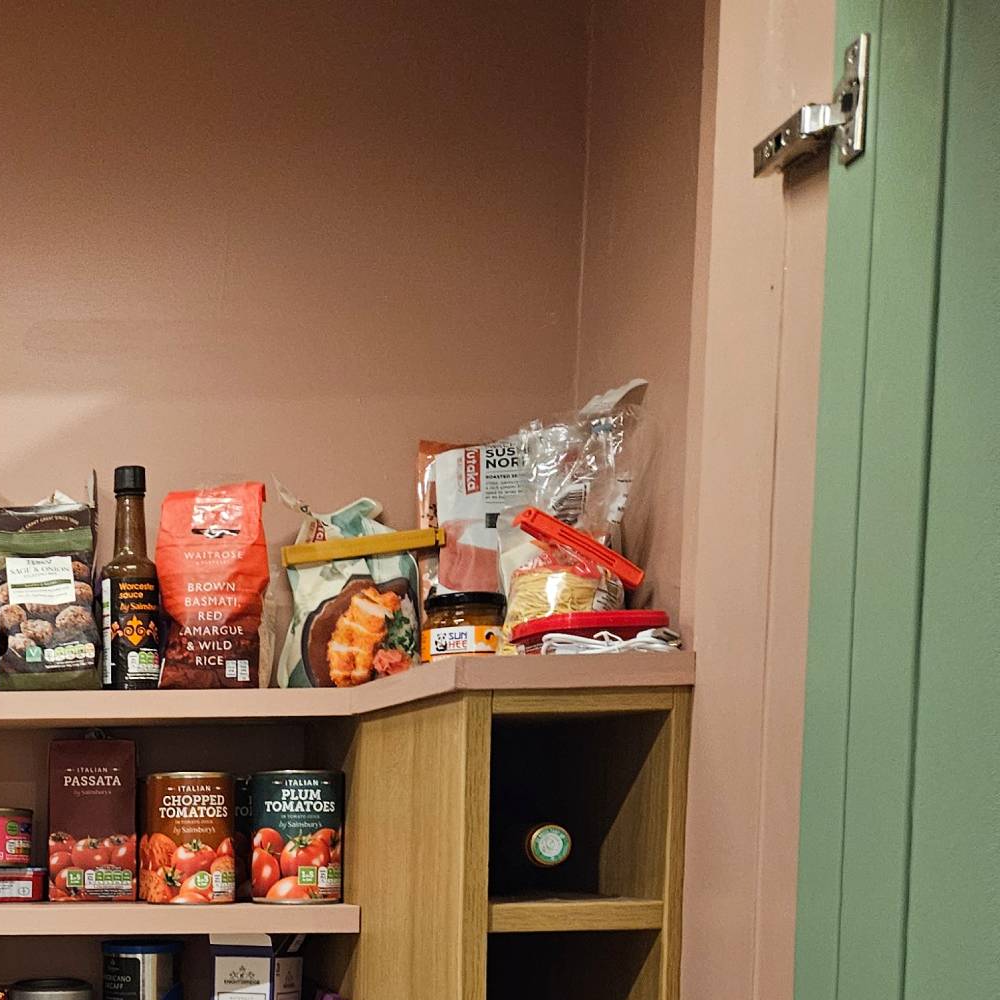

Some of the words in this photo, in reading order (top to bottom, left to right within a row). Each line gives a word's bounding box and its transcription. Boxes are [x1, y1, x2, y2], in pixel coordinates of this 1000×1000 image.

[184, 551, 245, 560] WAITROSE
[187, 582, 236, 592] BROWN
[119, 591, 144, 599] sauce
[198, 611, 223, 621] RED
[179, 626, 244, 636] AMARGUE
[448, 631, 468, 640] SUN
[186, 641, 195, 651] &
[198, 641, 233, 651] WILD
[448, 640, 468, 648] HEE
[195, 656, 224, 666] RICE
[64, 776, 121, 786] PASSATA
[281, 789, 321, 800] PLUM
[163, 795, 225, 806] CHOPPED
[265, 801, 335, 812] TOMATOES
[159, 806, 228, 818] TOMATOES
